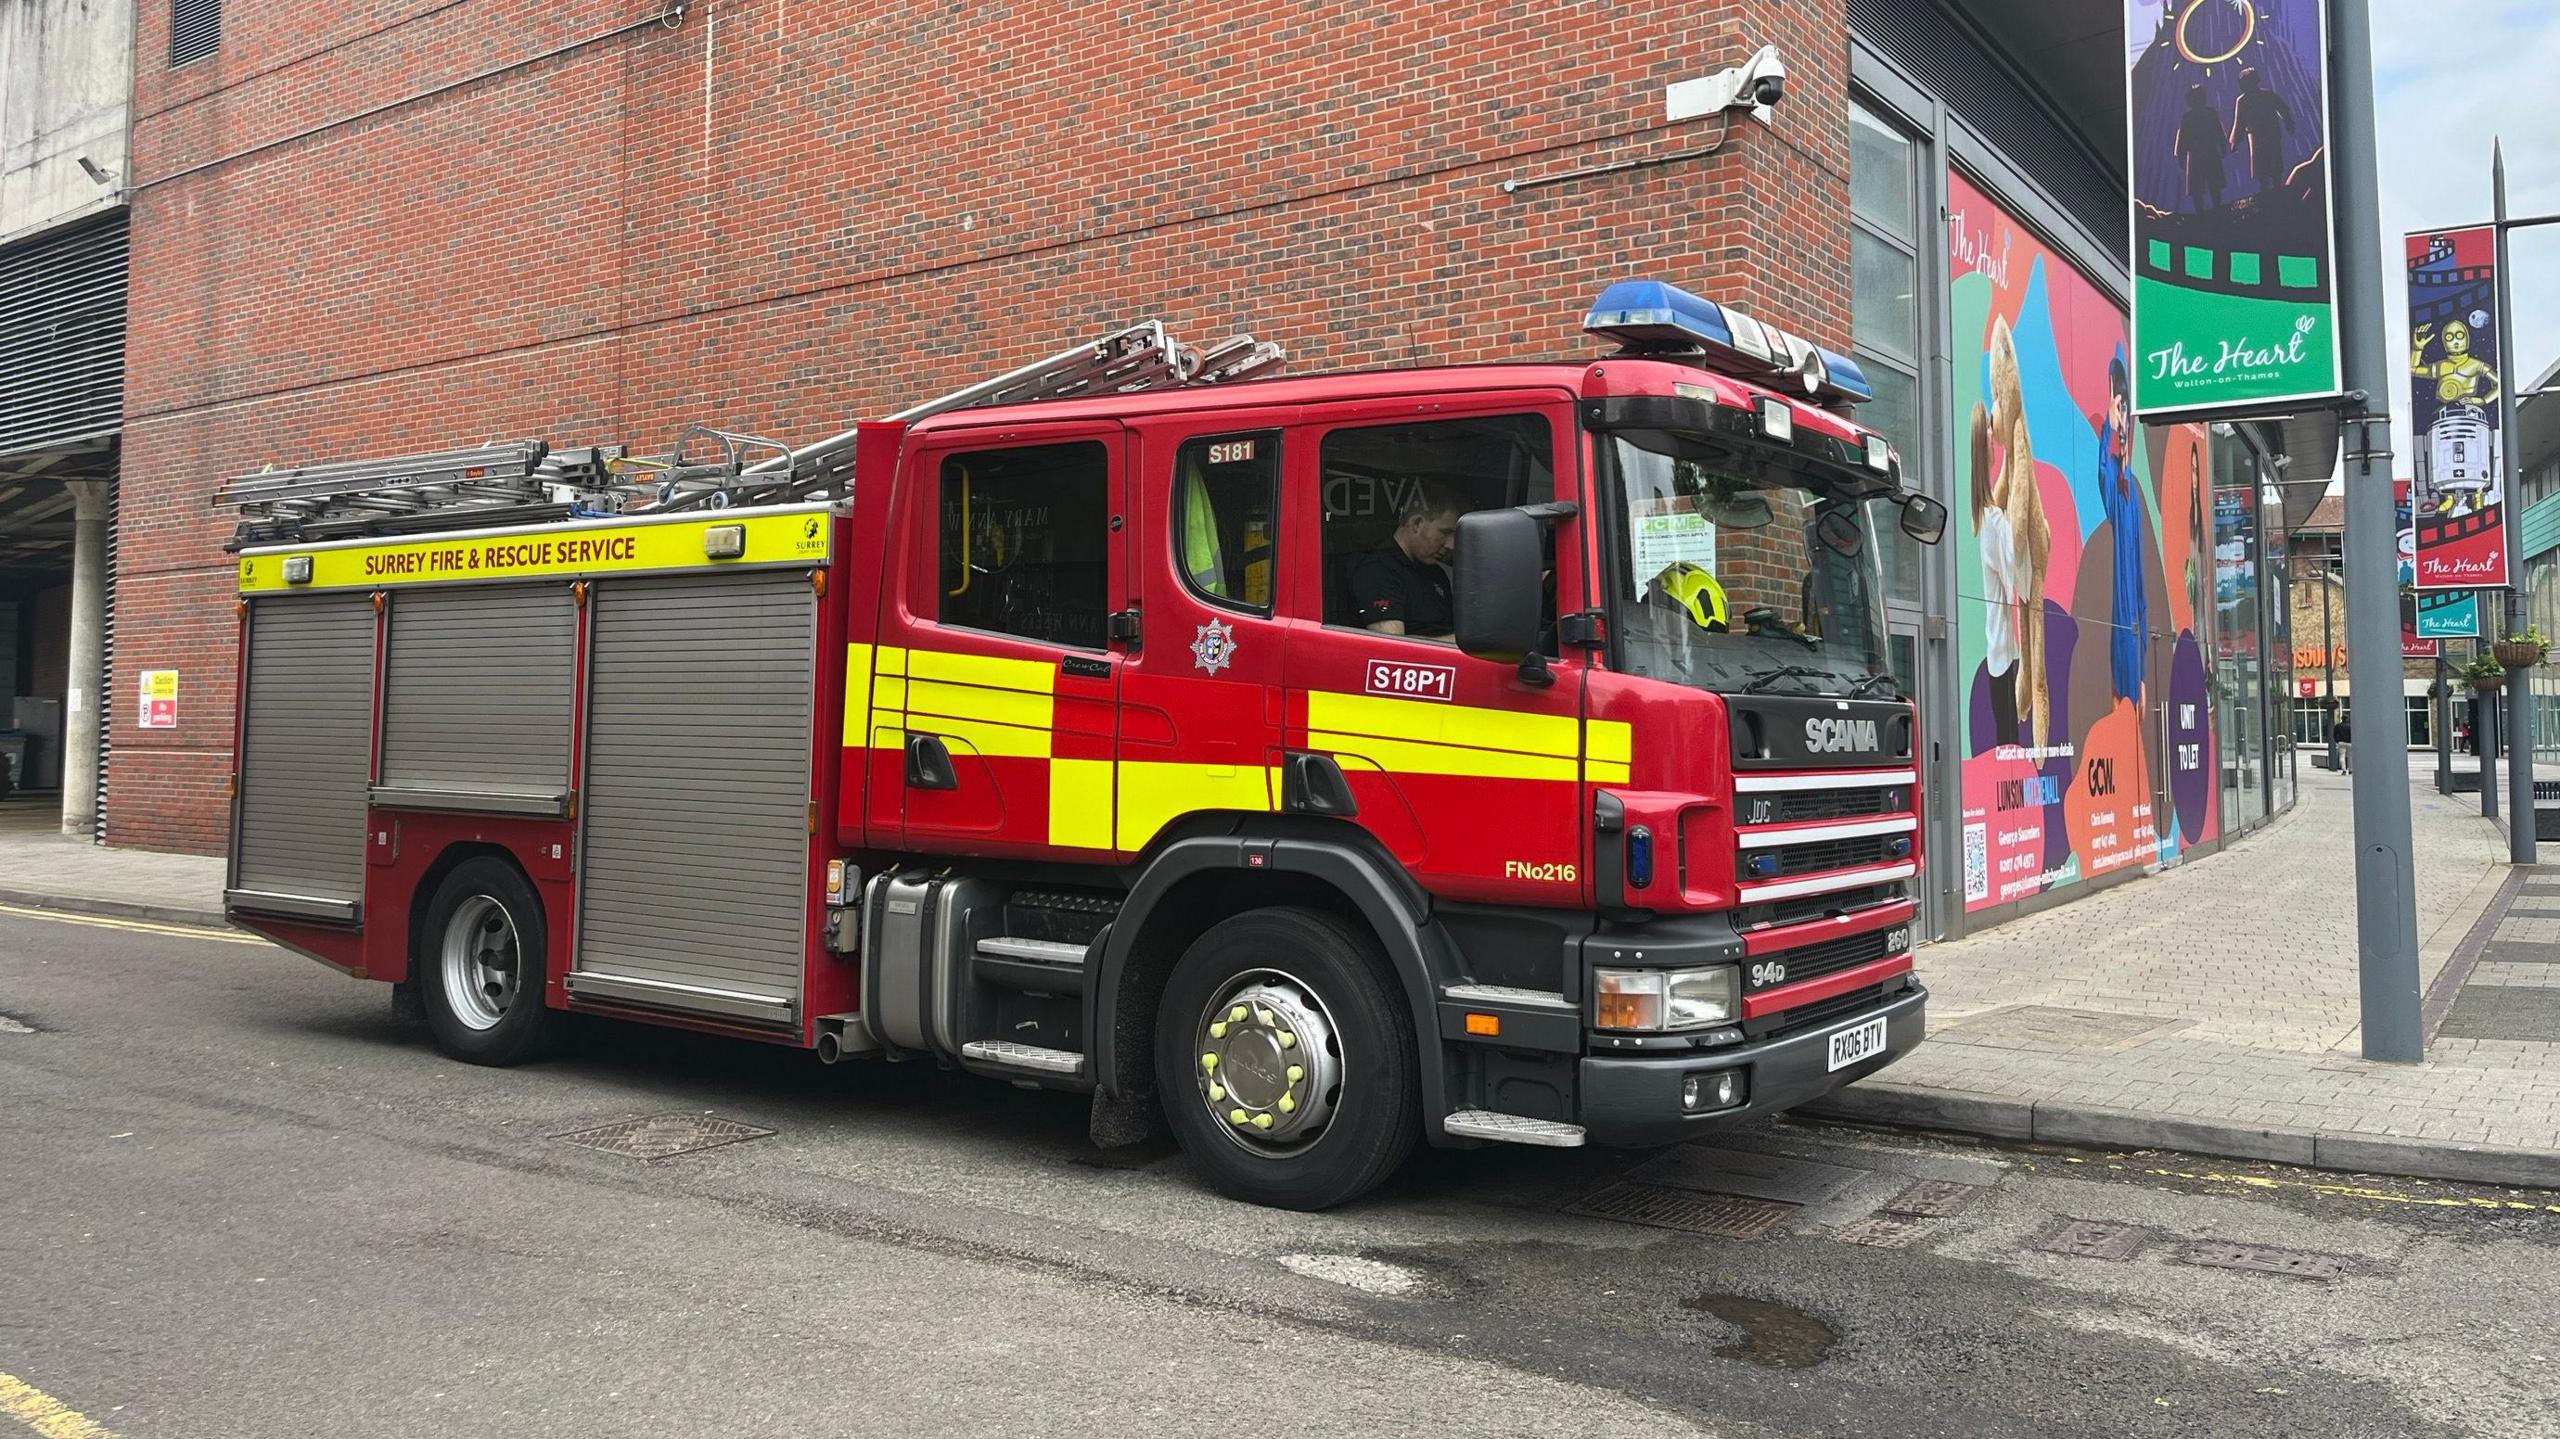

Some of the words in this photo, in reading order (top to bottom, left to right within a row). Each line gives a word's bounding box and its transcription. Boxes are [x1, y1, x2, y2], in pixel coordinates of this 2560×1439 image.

[1951, 208, 1975, 265] The
[1976, 229, 2009, 291] Heart
[2148, 341, 2208, 380] The
[2213, 331, 2306, 374] Heart
[2174, 371, 2280, 389] Walton-on-Thames
[1210, 441, 1250, 464] S181
[365, 552, 426, 576] SURREY
[430, 549, 464, 571] FIRE
[468, 547, 480, 569] &
[485, 543, 552, 568] RESCUE
[556, 537, 636, 563] SERVICE
[796, 540, 825, 549] SURREY
[2422, 557, 2451, 574] The
[2452, 557, 2494, 574] Heart
[2422, 617, 2440, 629] The
[2442, 616, 2469, 628] Heart
[1374, 666, 1446, 695] S18P1
[2180, 704, 2195, 730] UNIT
[1805, 717, 1879, 752] SCANIA
[2178, 744, 2188, 770] TO
[2188, 744, 2199, 770] LET
[1505, 860, 1576, 882] FNo216
[1887, 929, 1909, 952] 260
[1752, 962, 1785, 987] 94D
[1833, 1030, 1861, 1065] RX06
[1863, 1021, 1883, 1056] BTV
